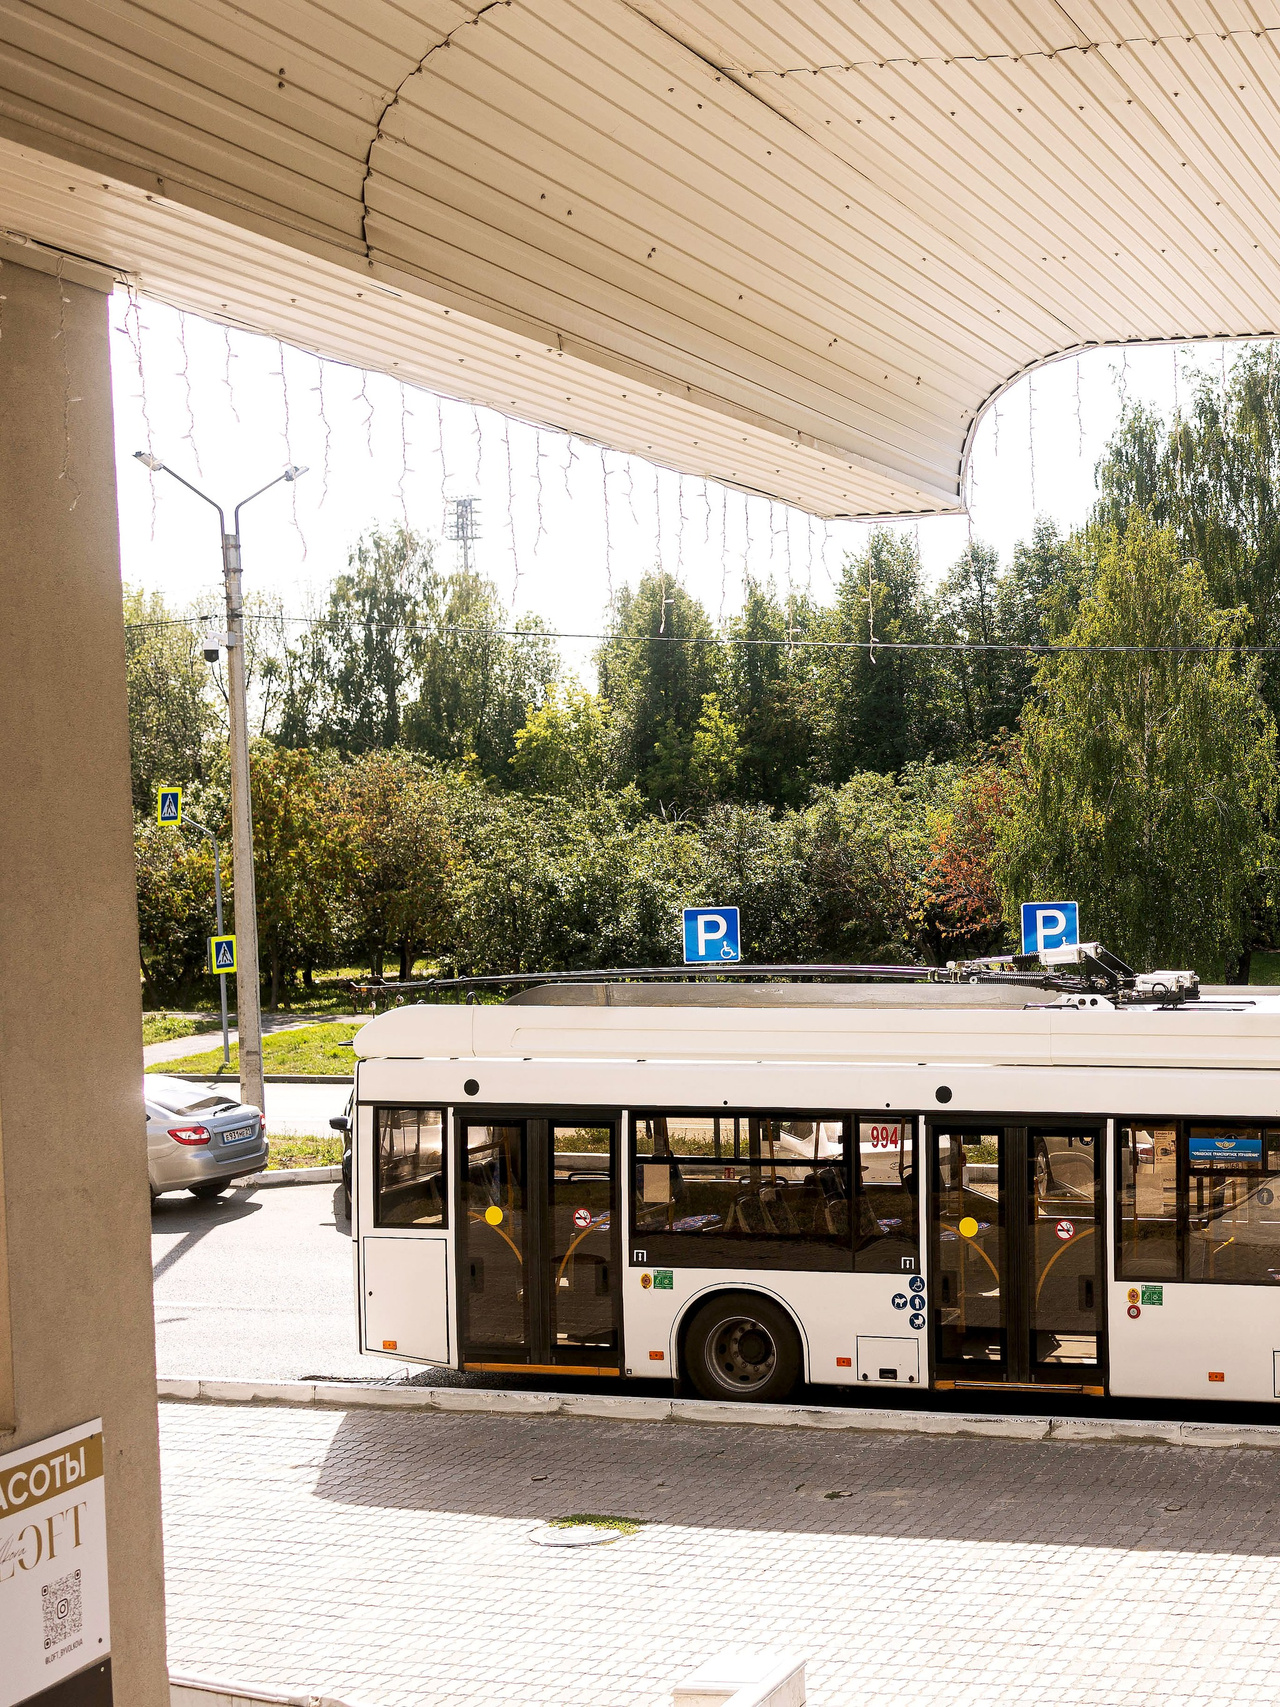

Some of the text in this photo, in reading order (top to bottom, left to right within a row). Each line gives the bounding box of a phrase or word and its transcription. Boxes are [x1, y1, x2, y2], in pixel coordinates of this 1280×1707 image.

[697, 914, 727, 956] P
[1036, 909, 1066, 951] P
[871, 1126, 899, 1149] 994
